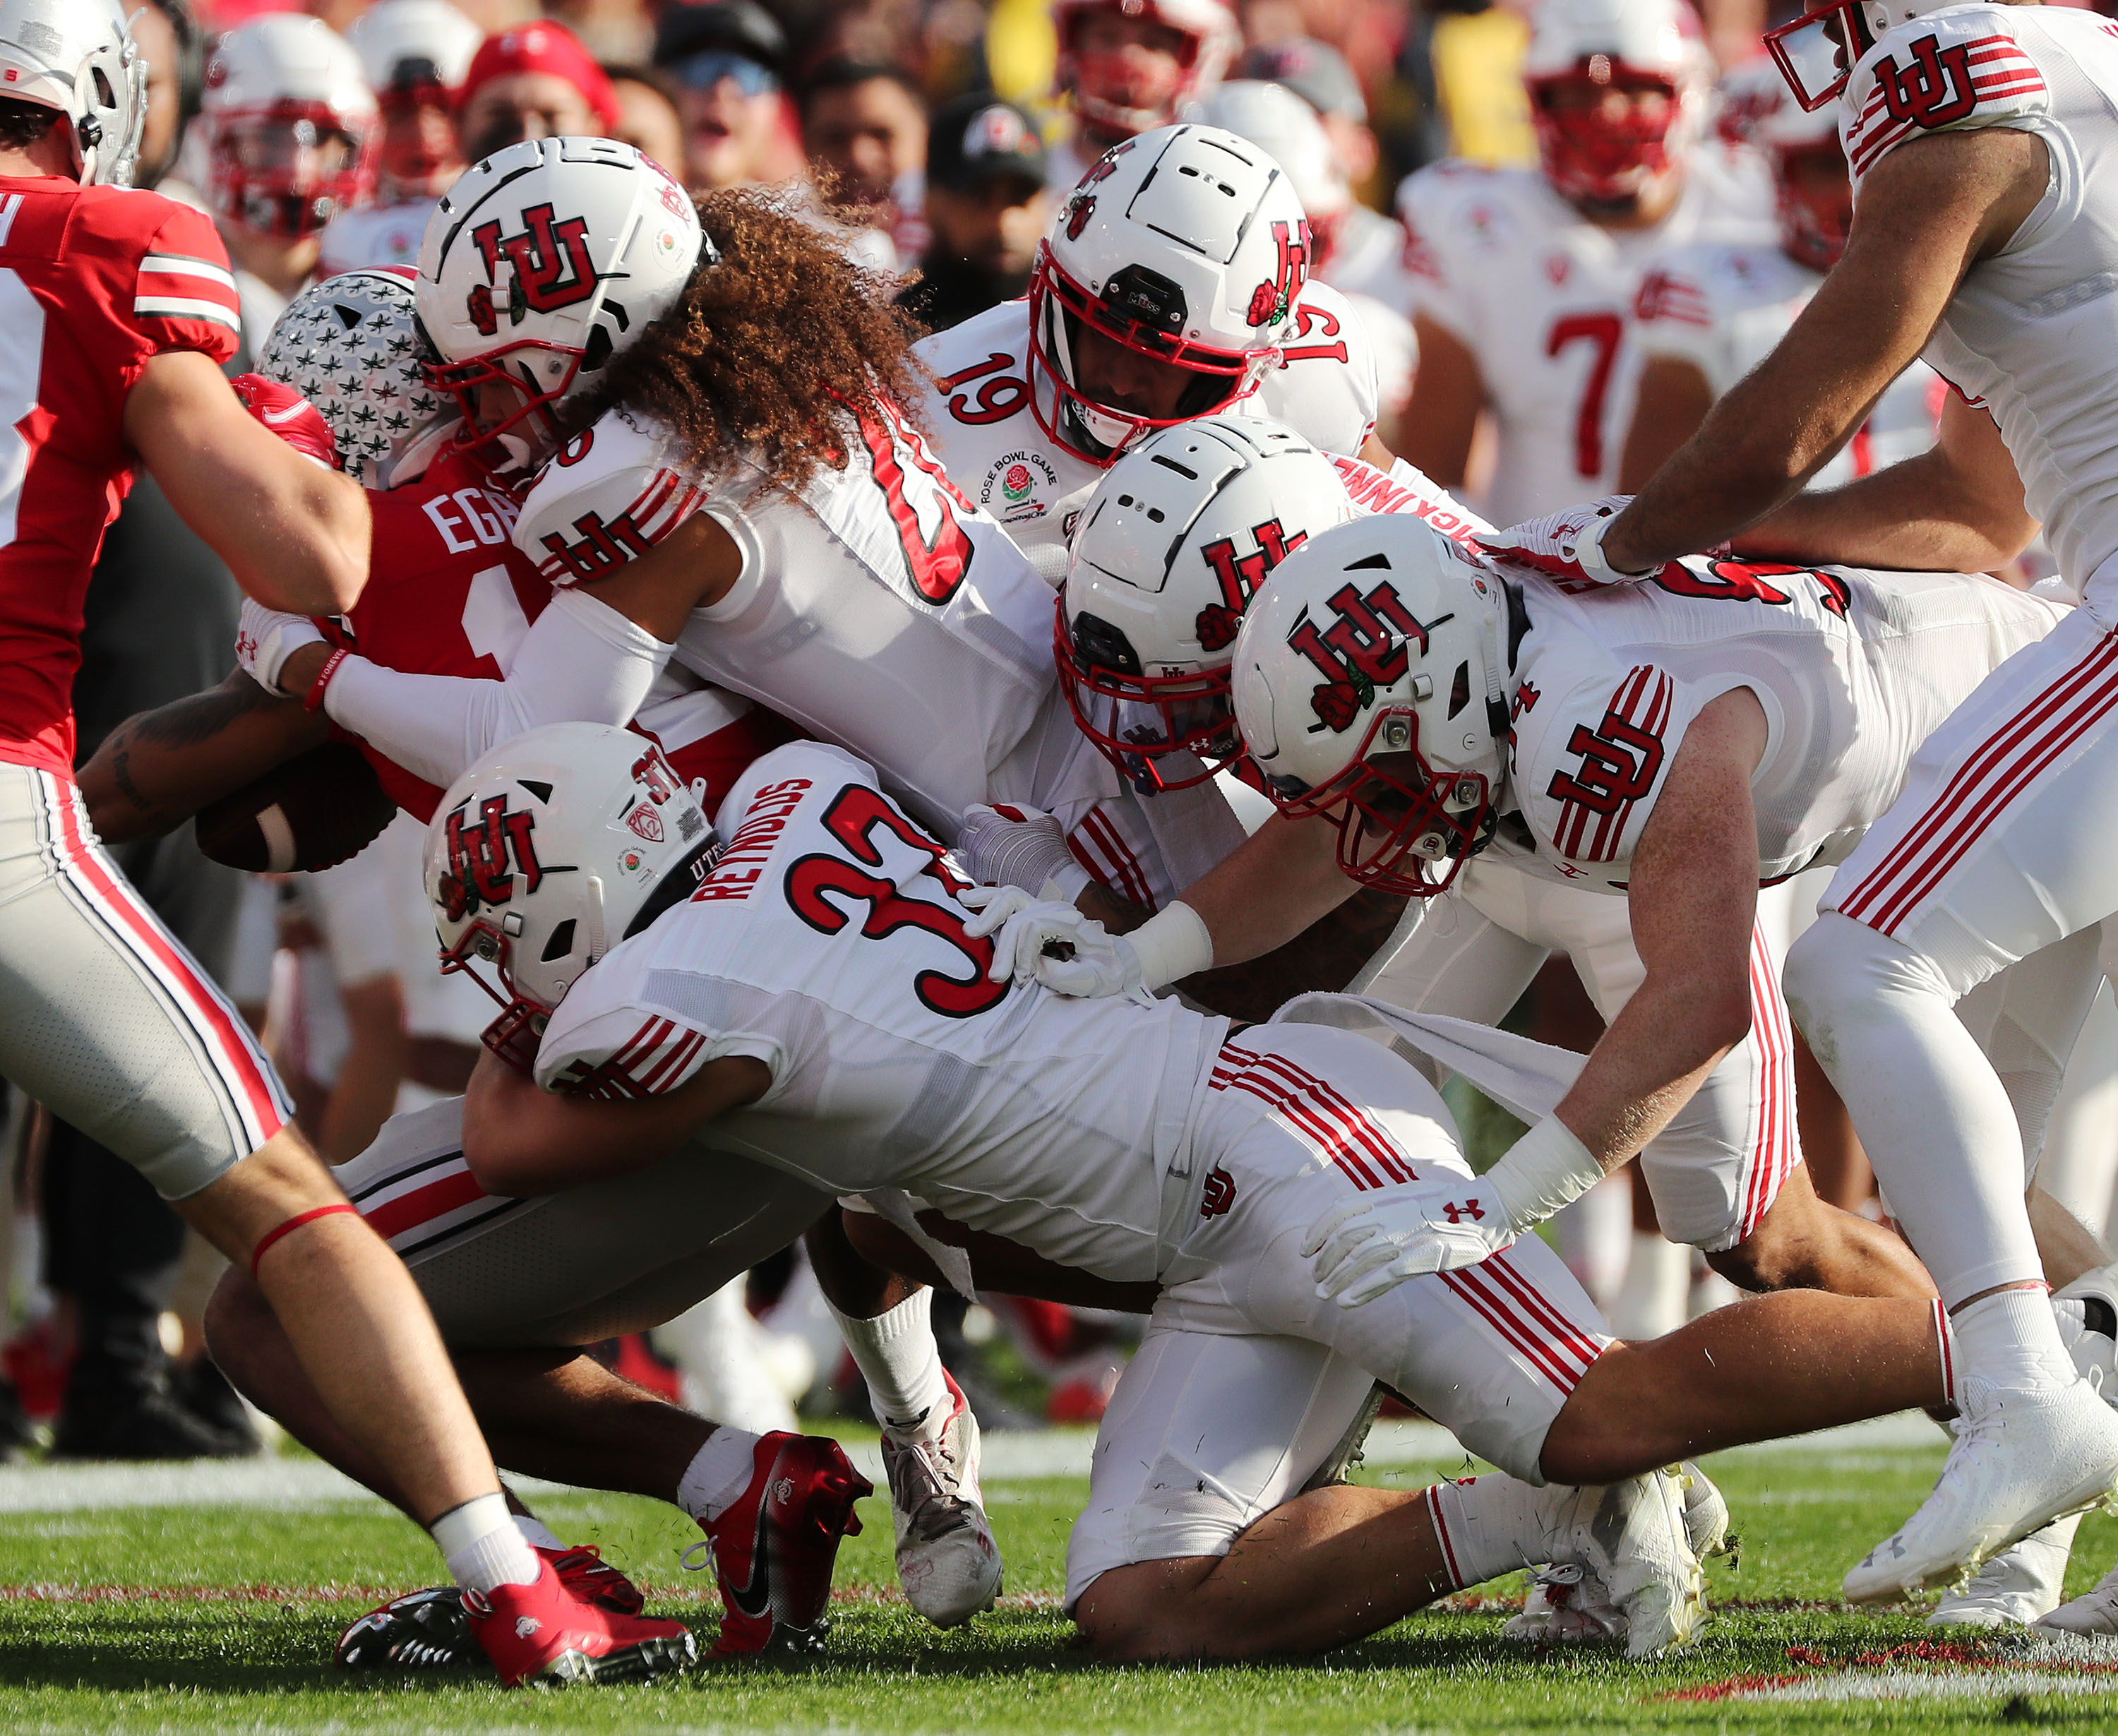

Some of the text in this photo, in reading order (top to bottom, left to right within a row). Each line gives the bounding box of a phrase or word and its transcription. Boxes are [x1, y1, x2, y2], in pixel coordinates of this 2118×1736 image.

[938, 352, 1029, 426] 19
[1546, 313, 1621, 479] 7
[981, 451, 1058, 504] ROSE BOWL GAME
[690, 778, 813, 903] REYNOLDS
